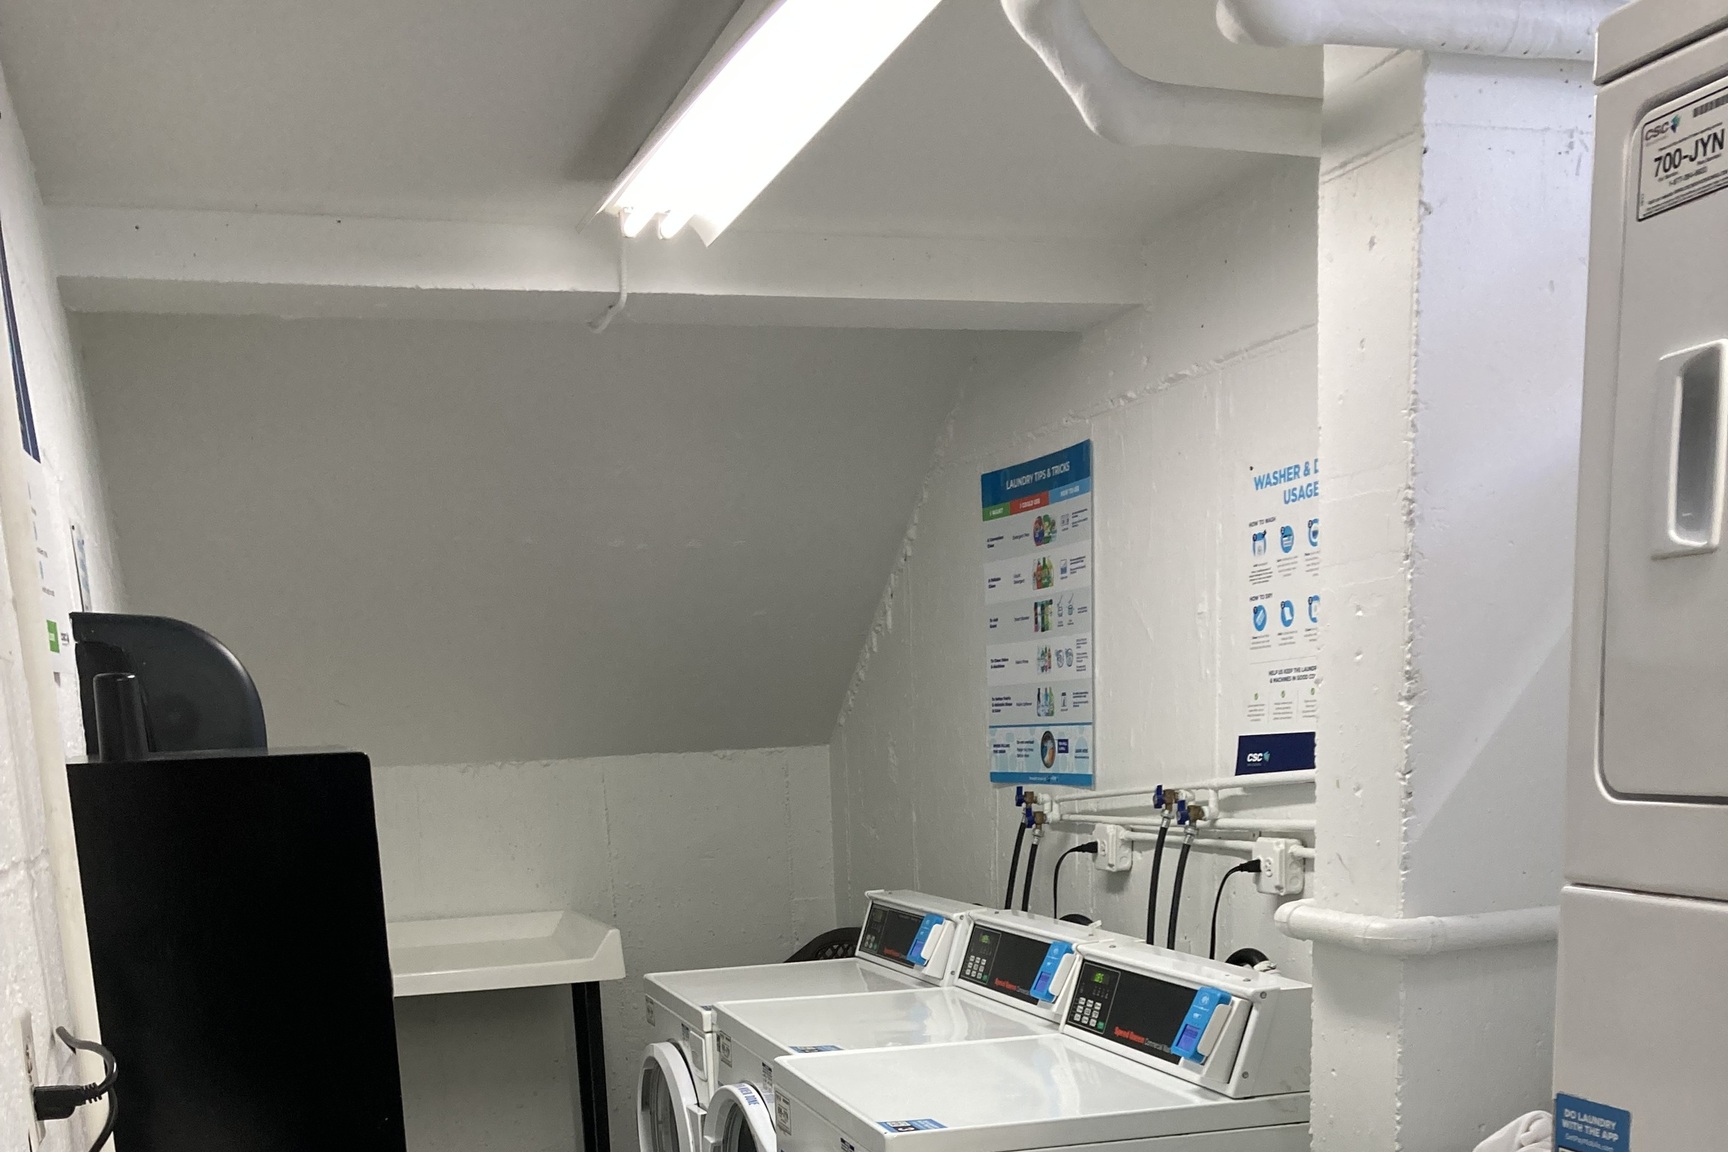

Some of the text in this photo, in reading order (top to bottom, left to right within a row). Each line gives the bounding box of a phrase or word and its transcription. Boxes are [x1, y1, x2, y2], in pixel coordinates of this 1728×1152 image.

[1645, 121, 1670, 141] CSC
[1654, 128, 1725, 178] 700-JYN
[1006, 461, 1070, 490] LAUNDRY TIPS & TRICKS
[1254, 464, 1300, 490] WASHER
[1304, 462, 1310, 477] &
[1284, 481, 1319, 504] USAGE
[1249, 519, 1258, 527] HOW
[1247, 752, 1263, 762] CSC
[1114, 1026, 1129, 1039] Speed
[1129, 1031, 1145, 1044] Queen
[1564, 1108, 1617, 1130] DO LAUNDRY
[1562, 1119, 1619, 1142] WITH THE APP
